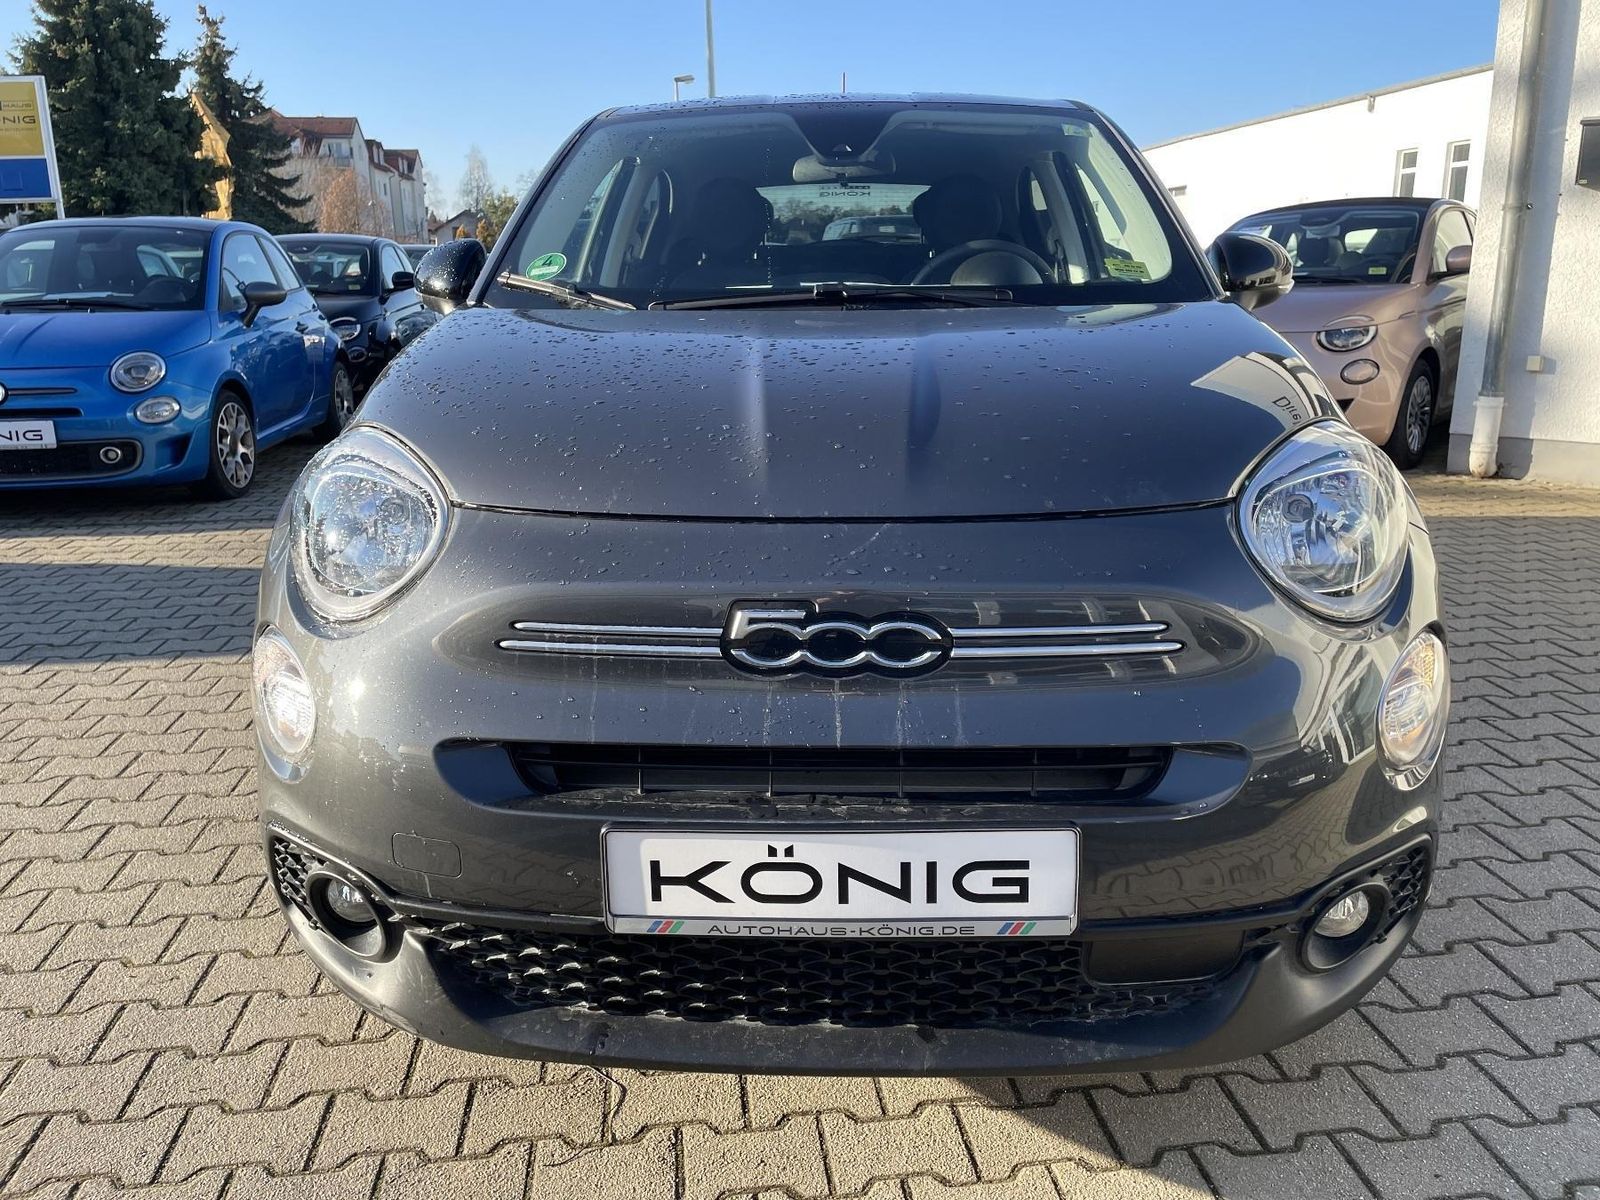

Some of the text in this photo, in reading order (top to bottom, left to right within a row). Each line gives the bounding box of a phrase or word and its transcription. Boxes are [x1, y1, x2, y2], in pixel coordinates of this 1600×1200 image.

[0, 115, 36, 124] NIG
[542, 255, 553, 266] 4
[730, 609, 942, 669] 500
[649, 844, 1030, 905] KÖNIG
[707, 924, 977, 937] AUTOHAUS-KÖNIG.DE
